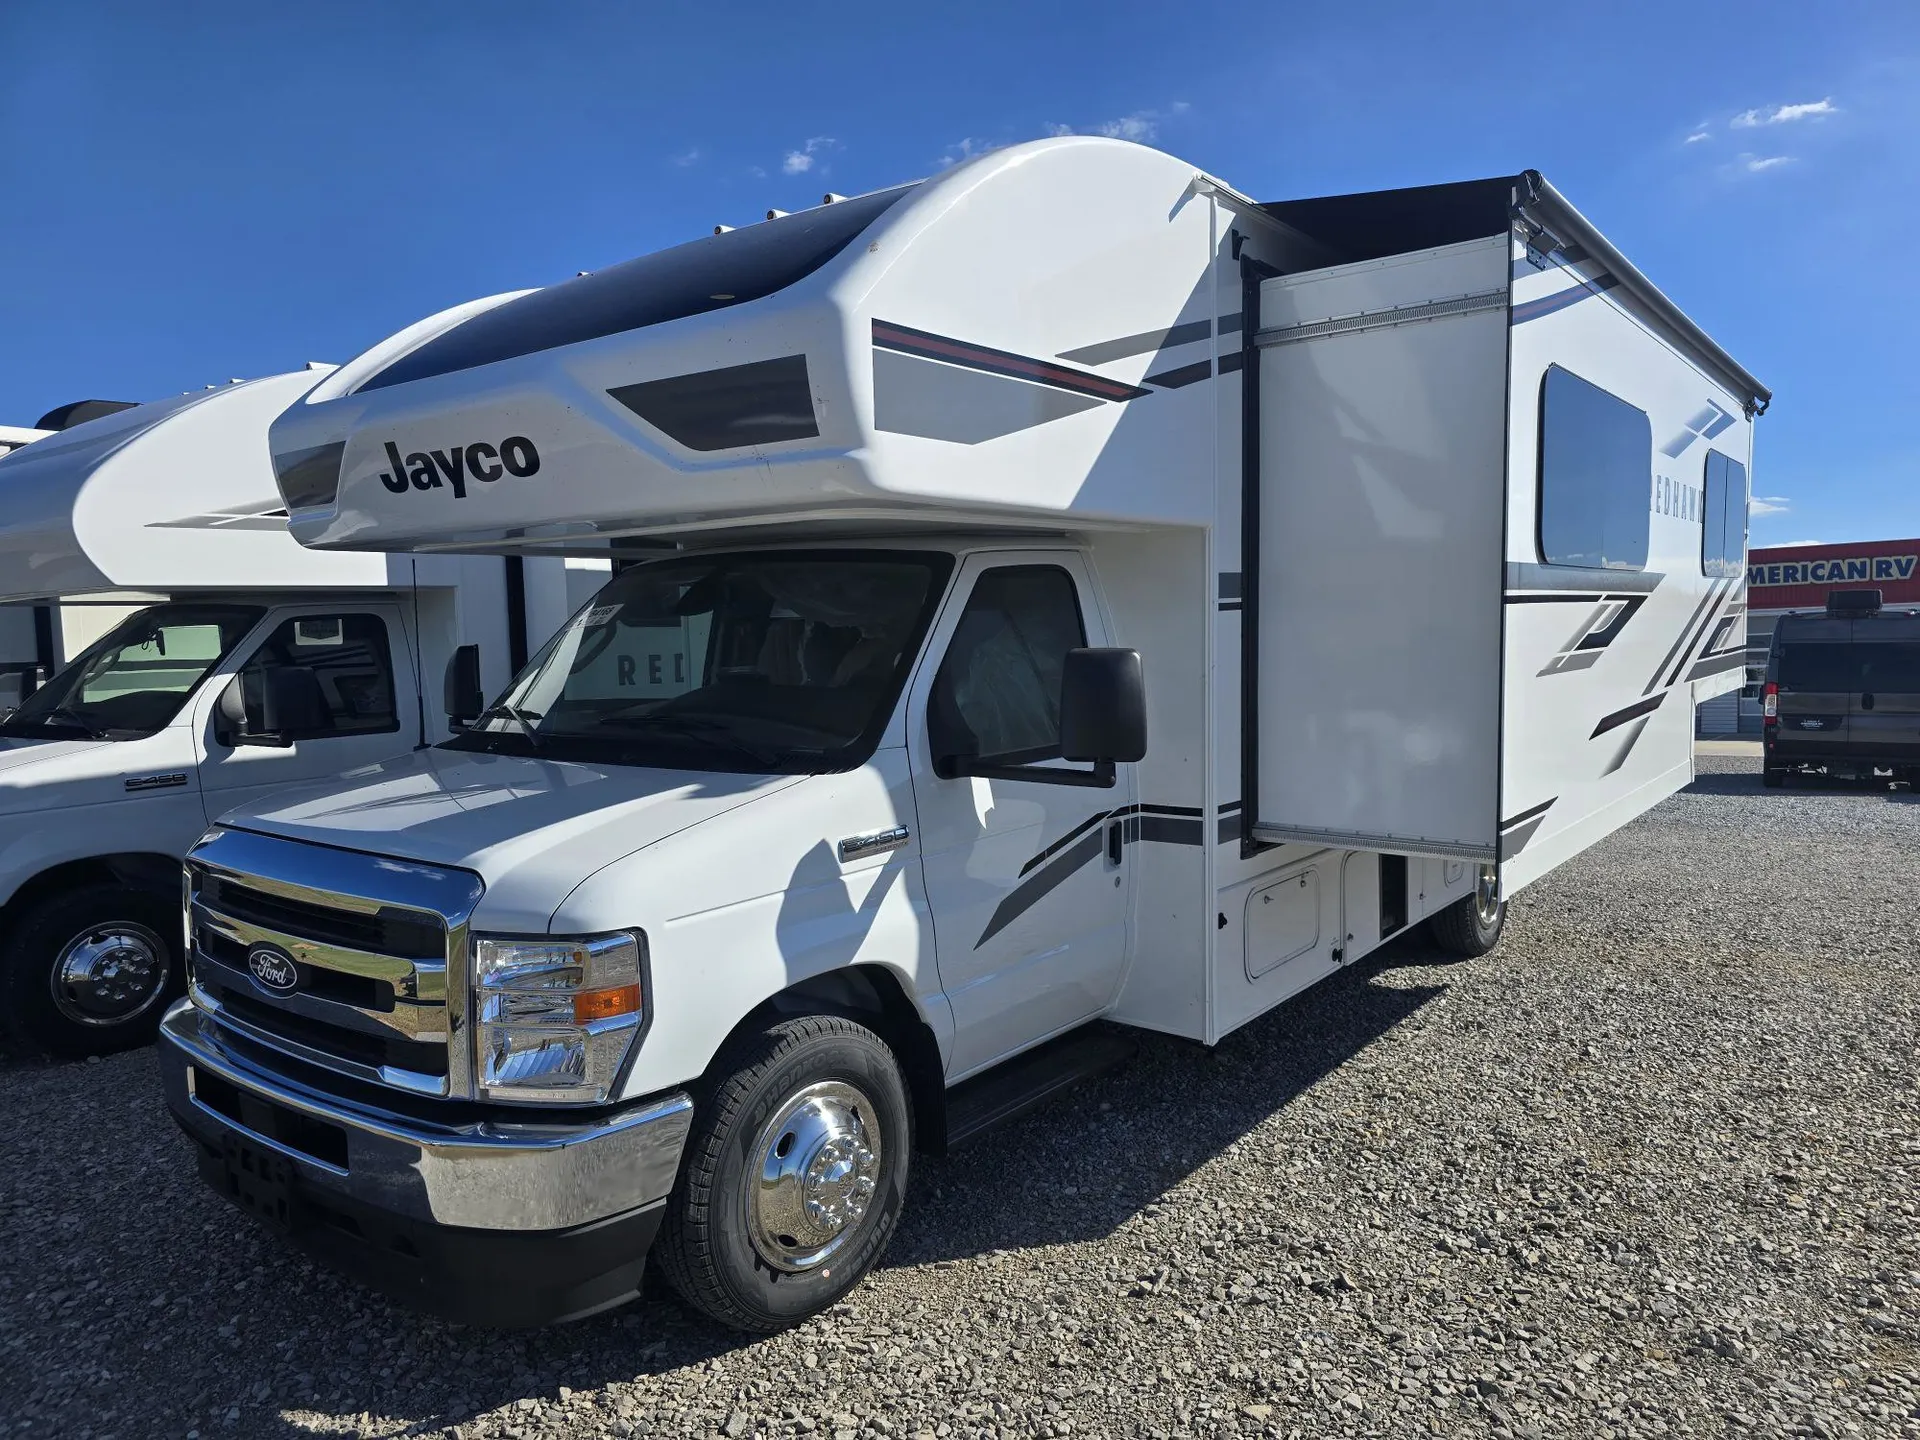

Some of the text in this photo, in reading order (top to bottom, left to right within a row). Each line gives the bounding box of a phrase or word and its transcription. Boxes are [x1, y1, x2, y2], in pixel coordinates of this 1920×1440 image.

[379, 436, 541, 499] Jayco
[1650, 474, 1704, 523] EDHAWK
[1747, 558, 1915, 585] MERICAN RV
[257, 954, 287, 984] Ford
